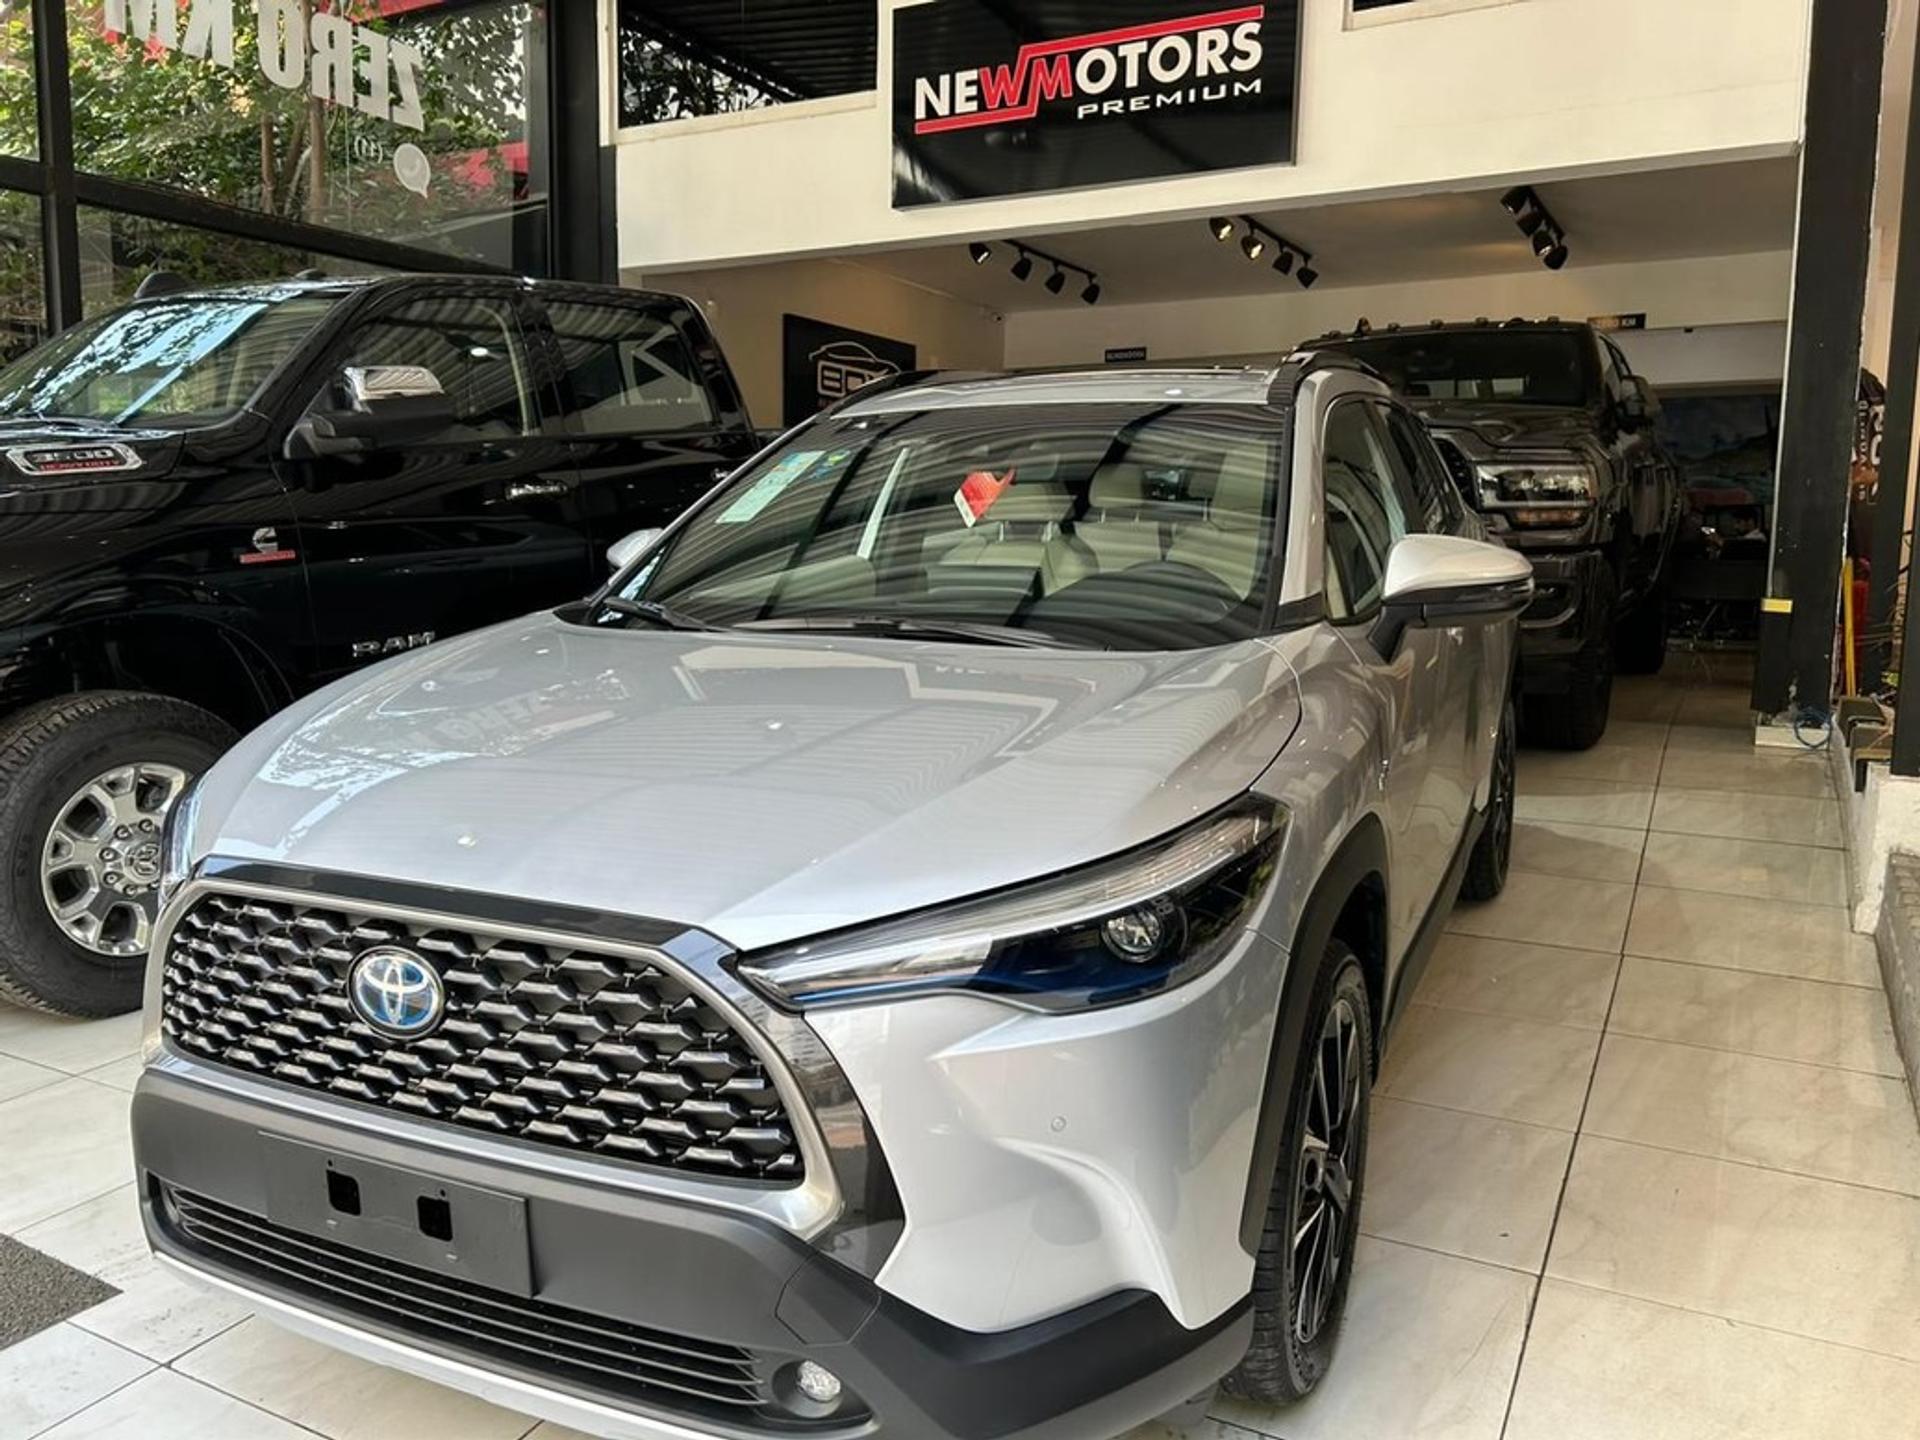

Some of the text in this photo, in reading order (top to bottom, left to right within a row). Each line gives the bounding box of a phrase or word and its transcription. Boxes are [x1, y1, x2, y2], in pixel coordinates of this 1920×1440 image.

[914, 21, 1264, 120] NEWMOTORS
[1077, 78, 1262, 120] PREMIUM
[352, 631, 435, 658] RAM
